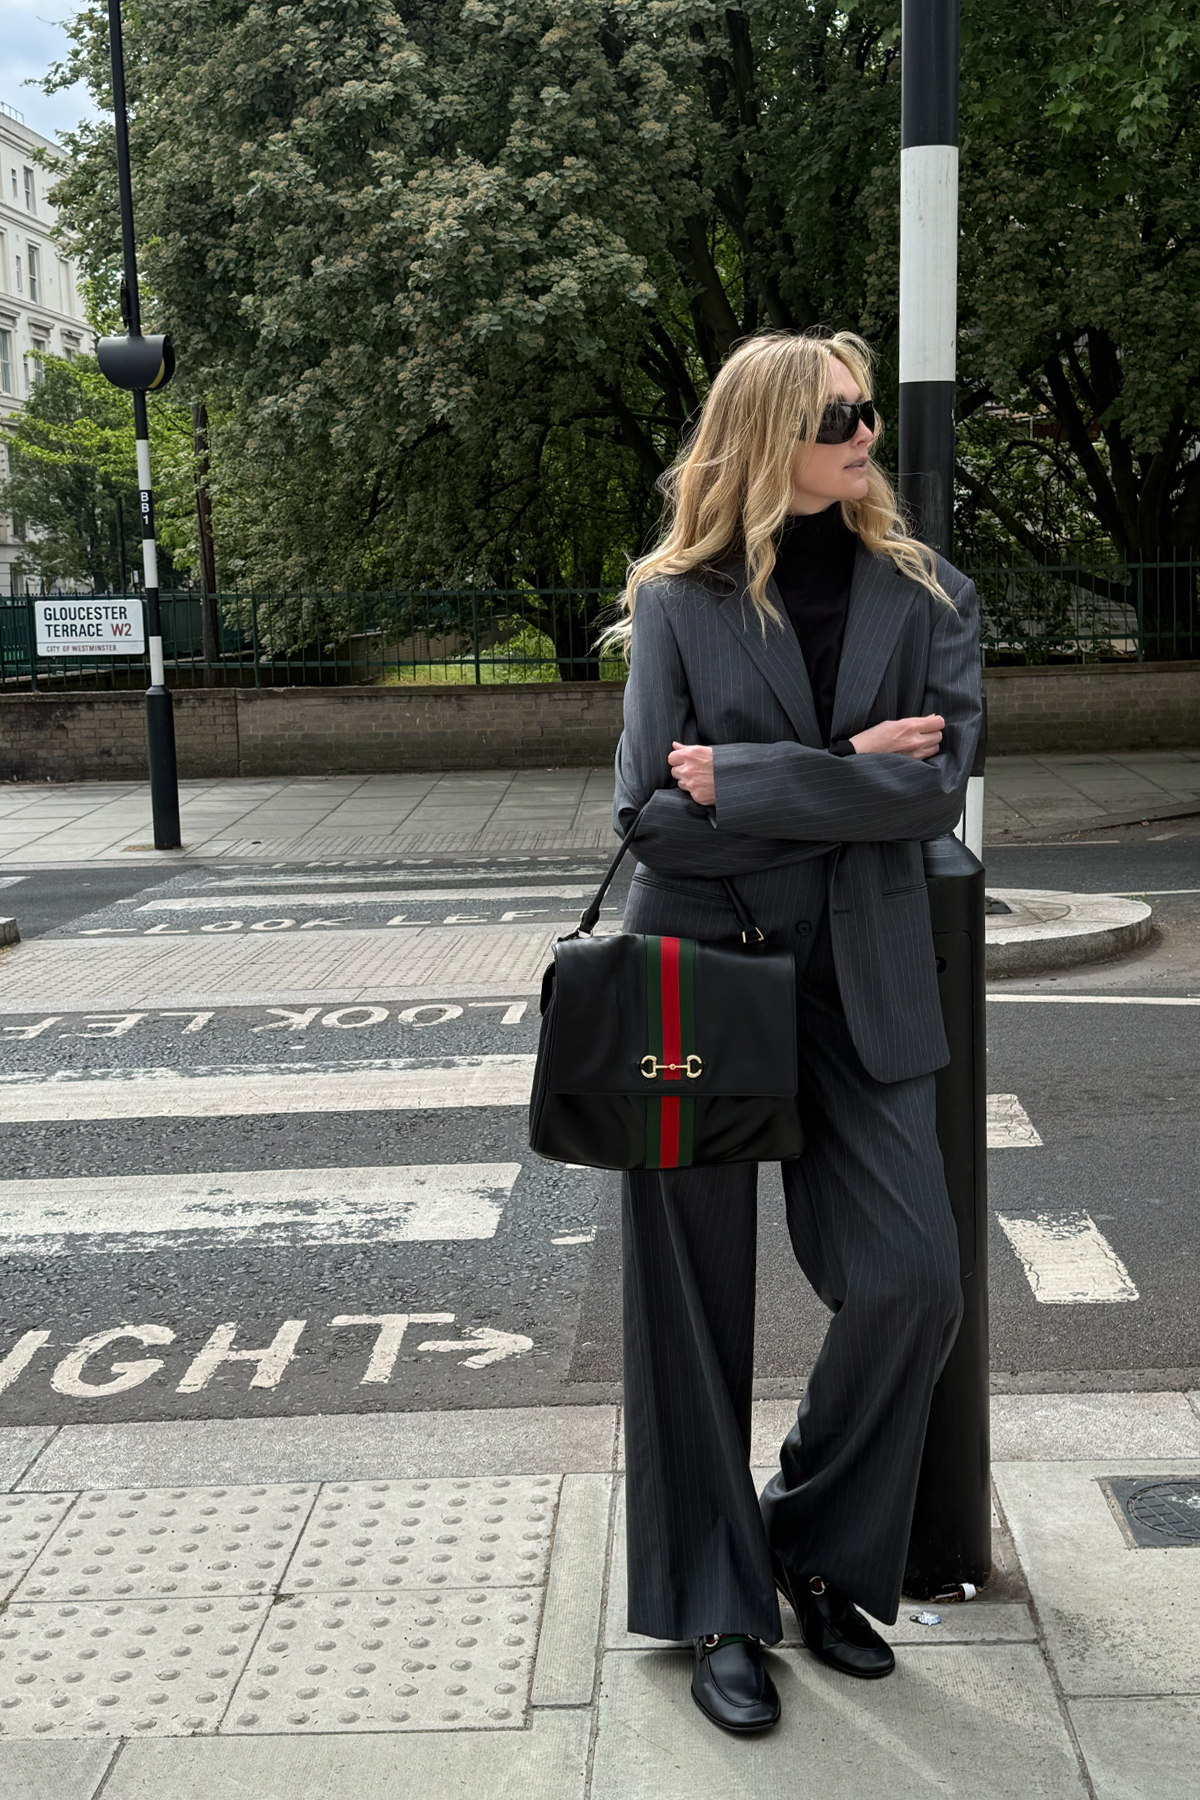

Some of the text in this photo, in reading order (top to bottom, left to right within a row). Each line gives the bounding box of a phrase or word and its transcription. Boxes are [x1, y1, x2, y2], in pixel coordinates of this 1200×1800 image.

[140, 491, 150, 525] BB1
[43, 606, 127, 621] GLOUCESTER
[45, 623, 132, 637] TERRACE W2
[46, 645, 60, 653] CITY
[72, 644, 118, 652] WESTMINSTER
[143, 916, 353, 934] LOOK
[248, 1001, 528, 1032] LOOK
[0, 1312, 456, 1397] IGHT
